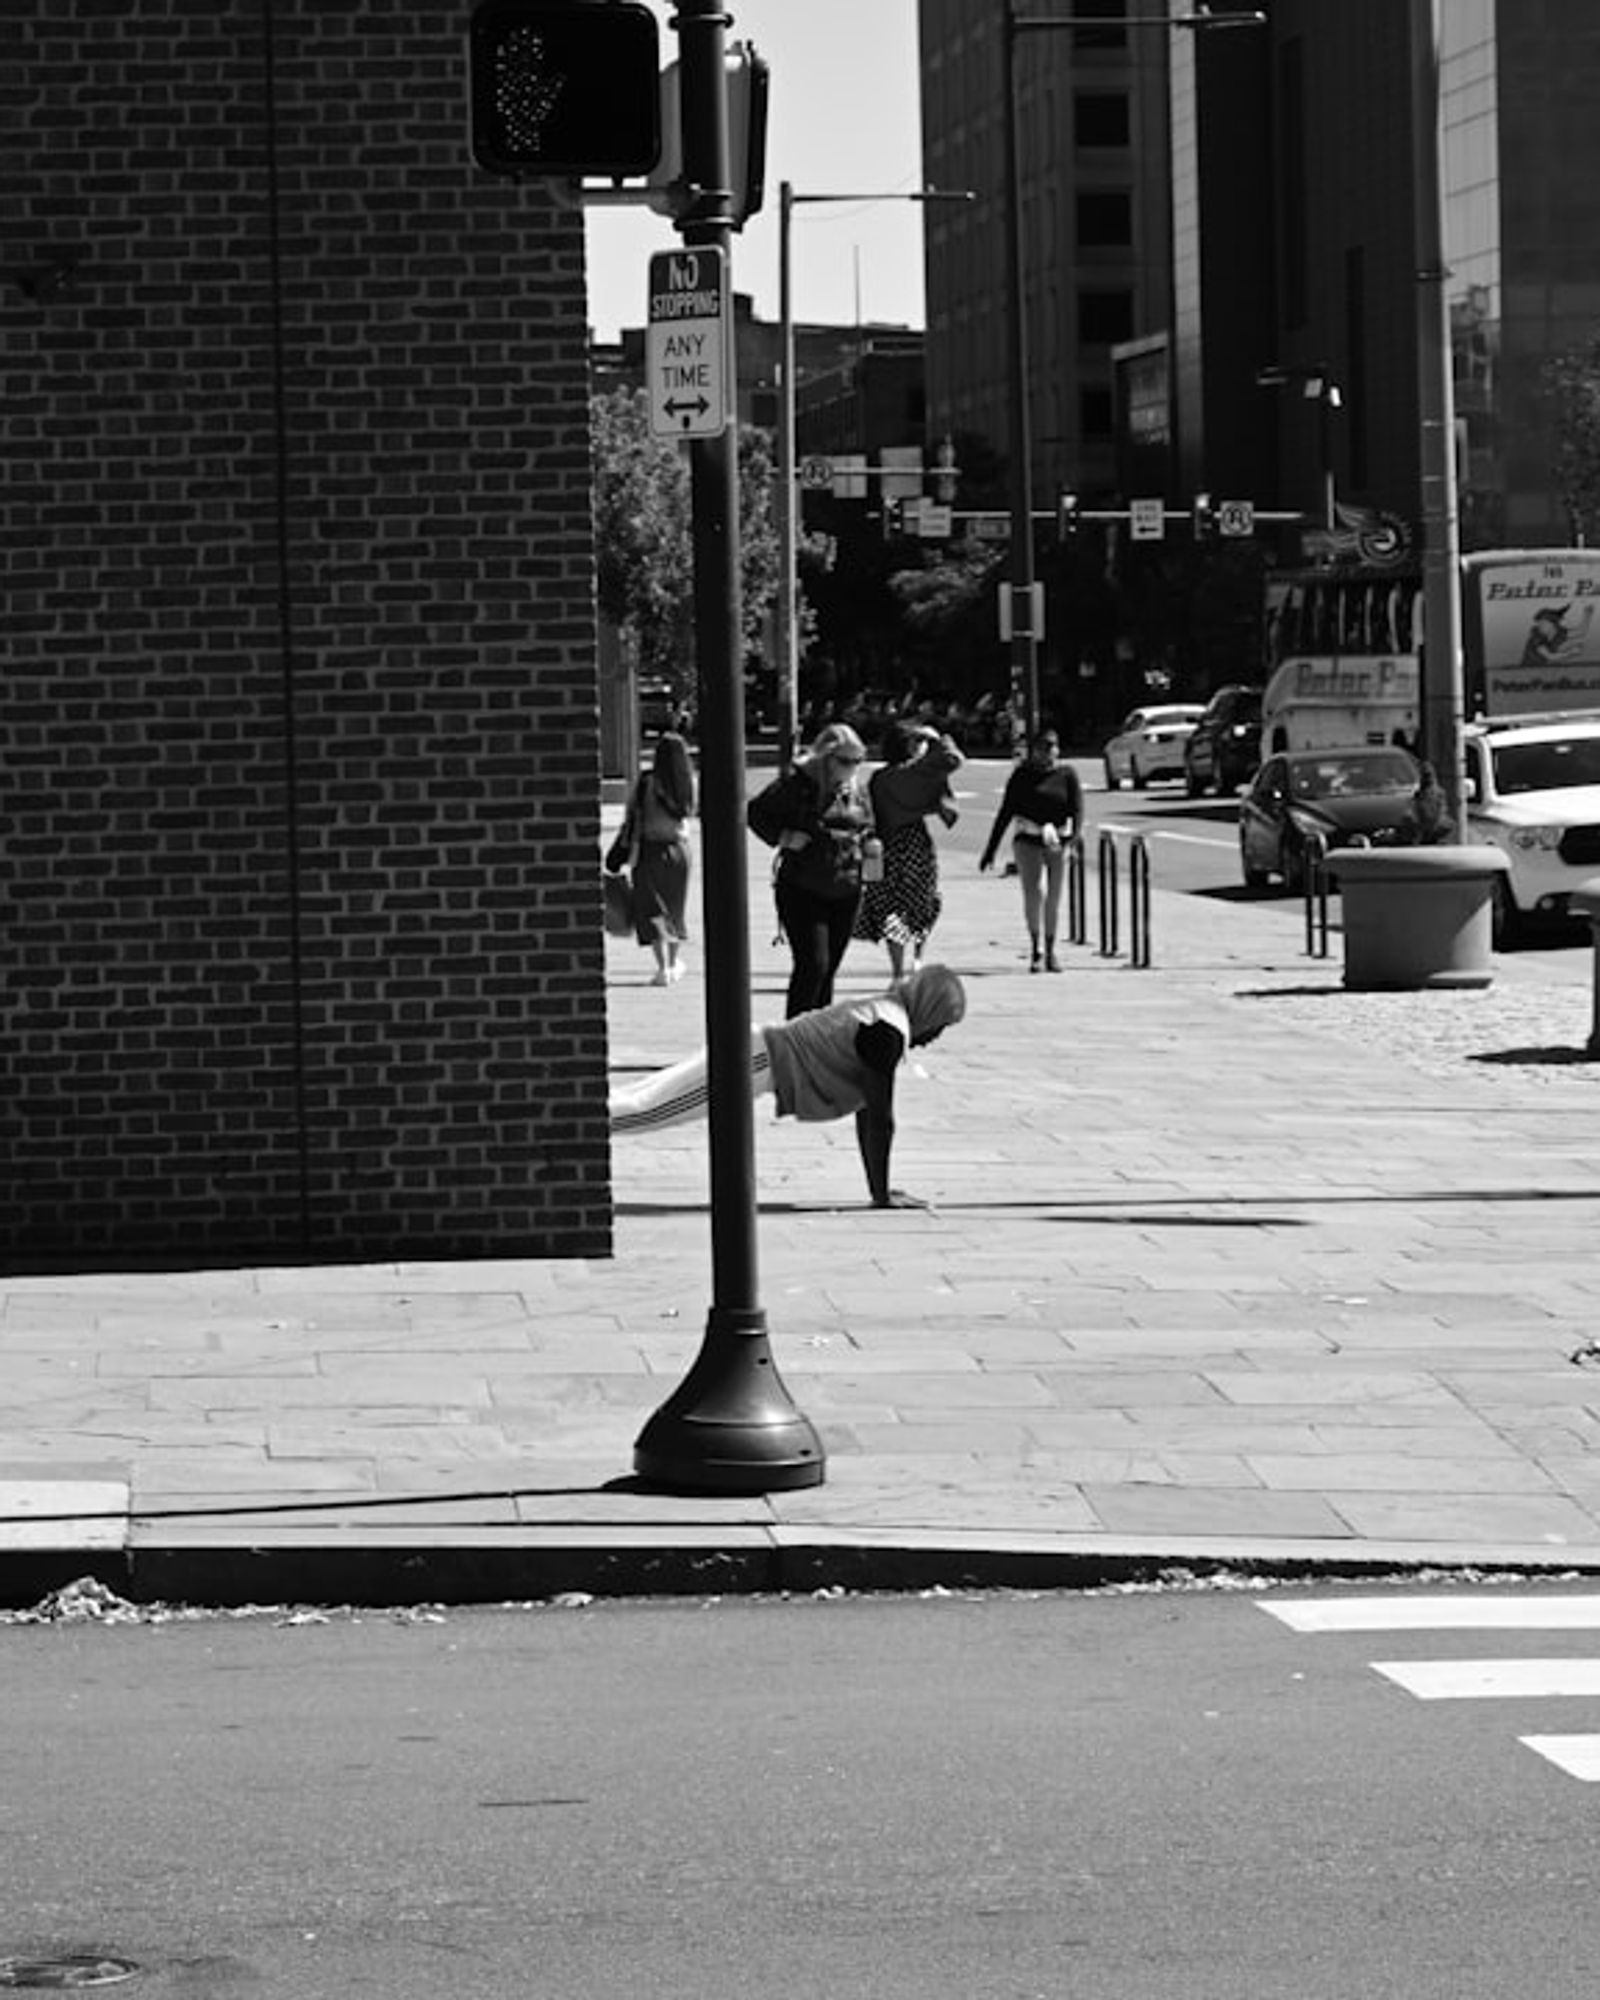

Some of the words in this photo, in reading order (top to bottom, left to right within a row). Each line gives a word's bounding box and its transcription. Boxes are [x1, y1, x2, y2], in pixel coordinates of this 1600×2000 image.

[669, 255, 699, 290] NO
[653, 289, 718, 318] STOPPING
[664, 333, 706, 357] ANY
[660, 363, 711, 388] TIME
